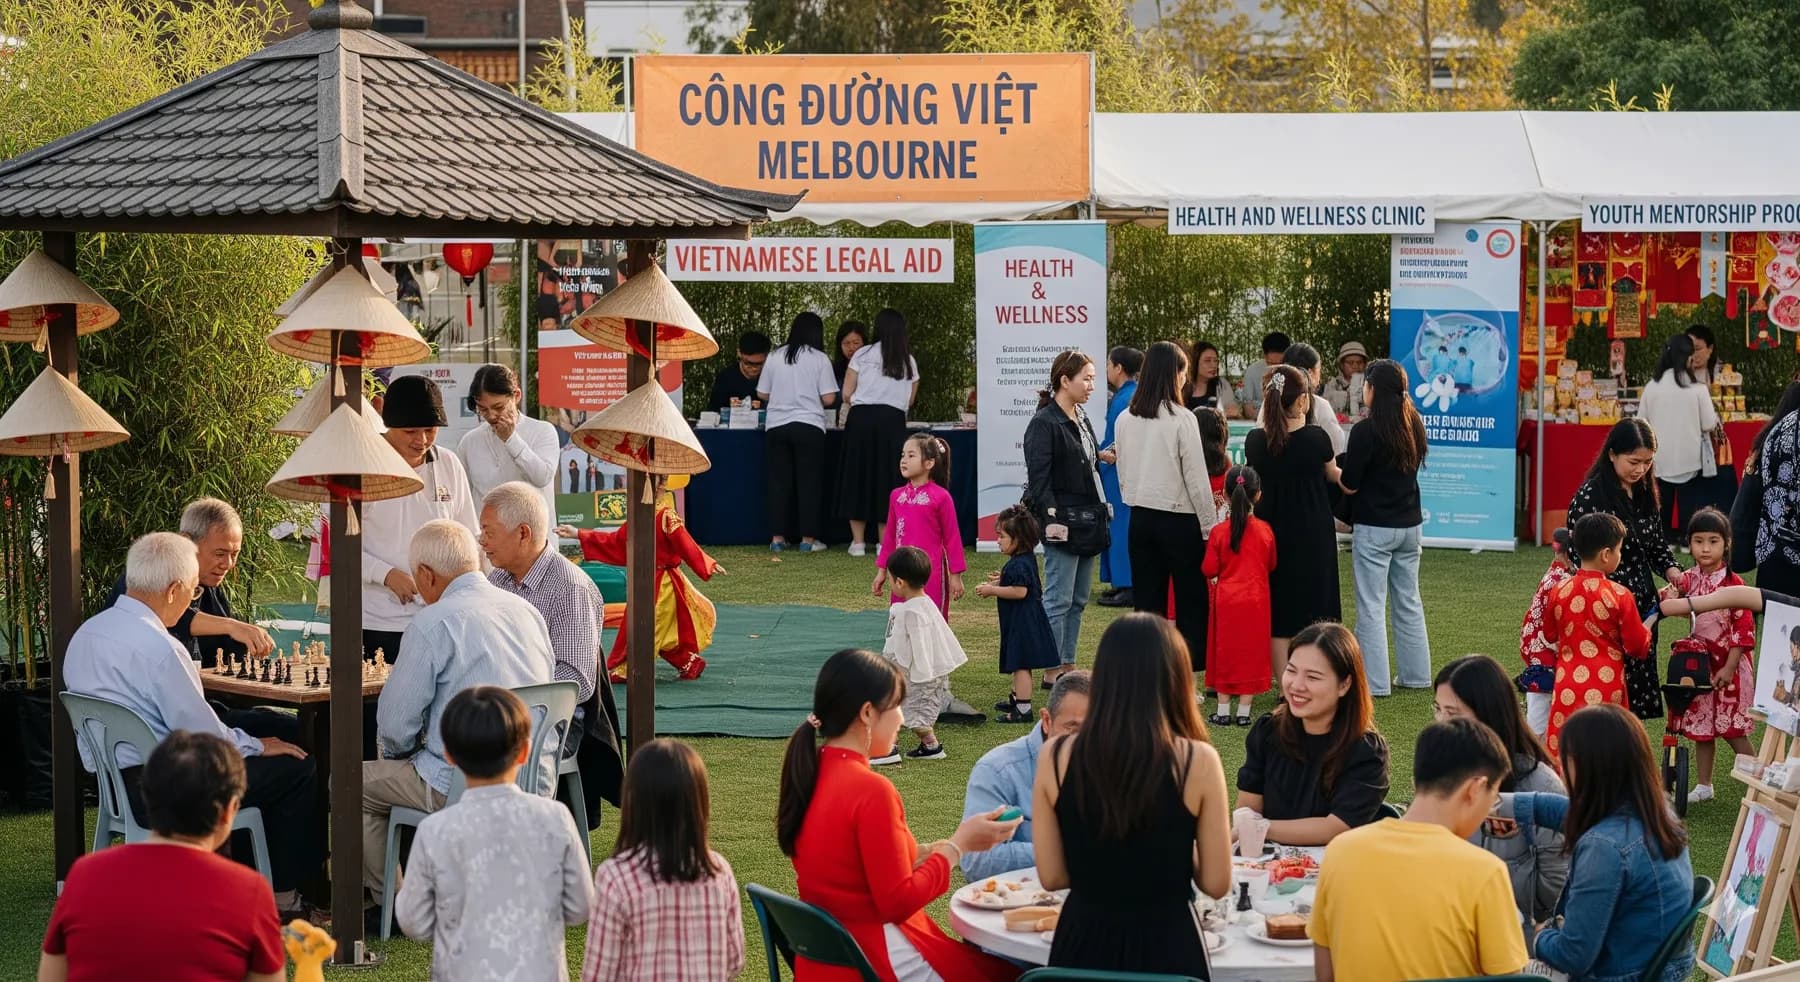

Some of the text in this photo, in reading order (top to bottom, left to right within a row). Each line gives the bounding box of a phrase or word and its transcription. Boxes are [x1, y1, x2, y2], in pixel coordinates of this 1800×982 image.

[679, 71, 1038, 135] CÔNG ĐƯỜNG VIỆT
[758, 140, 978, 180] MELBOURNE
[1176, 205, 1426, 227] HEALTH AND WELLNESS CLINIC
[1589, 204, 1644, 225] YOUTH
[1649, 203, 1757, 224] MENTORSHIP
[675, 245, 943, 273] VIETNAMESE LEGAL AID
[1005, 259, 1074, 278] HEALTH
[1031, 281, 1047, 300] &
[995, 305, 1089, 324] WELLNESS
